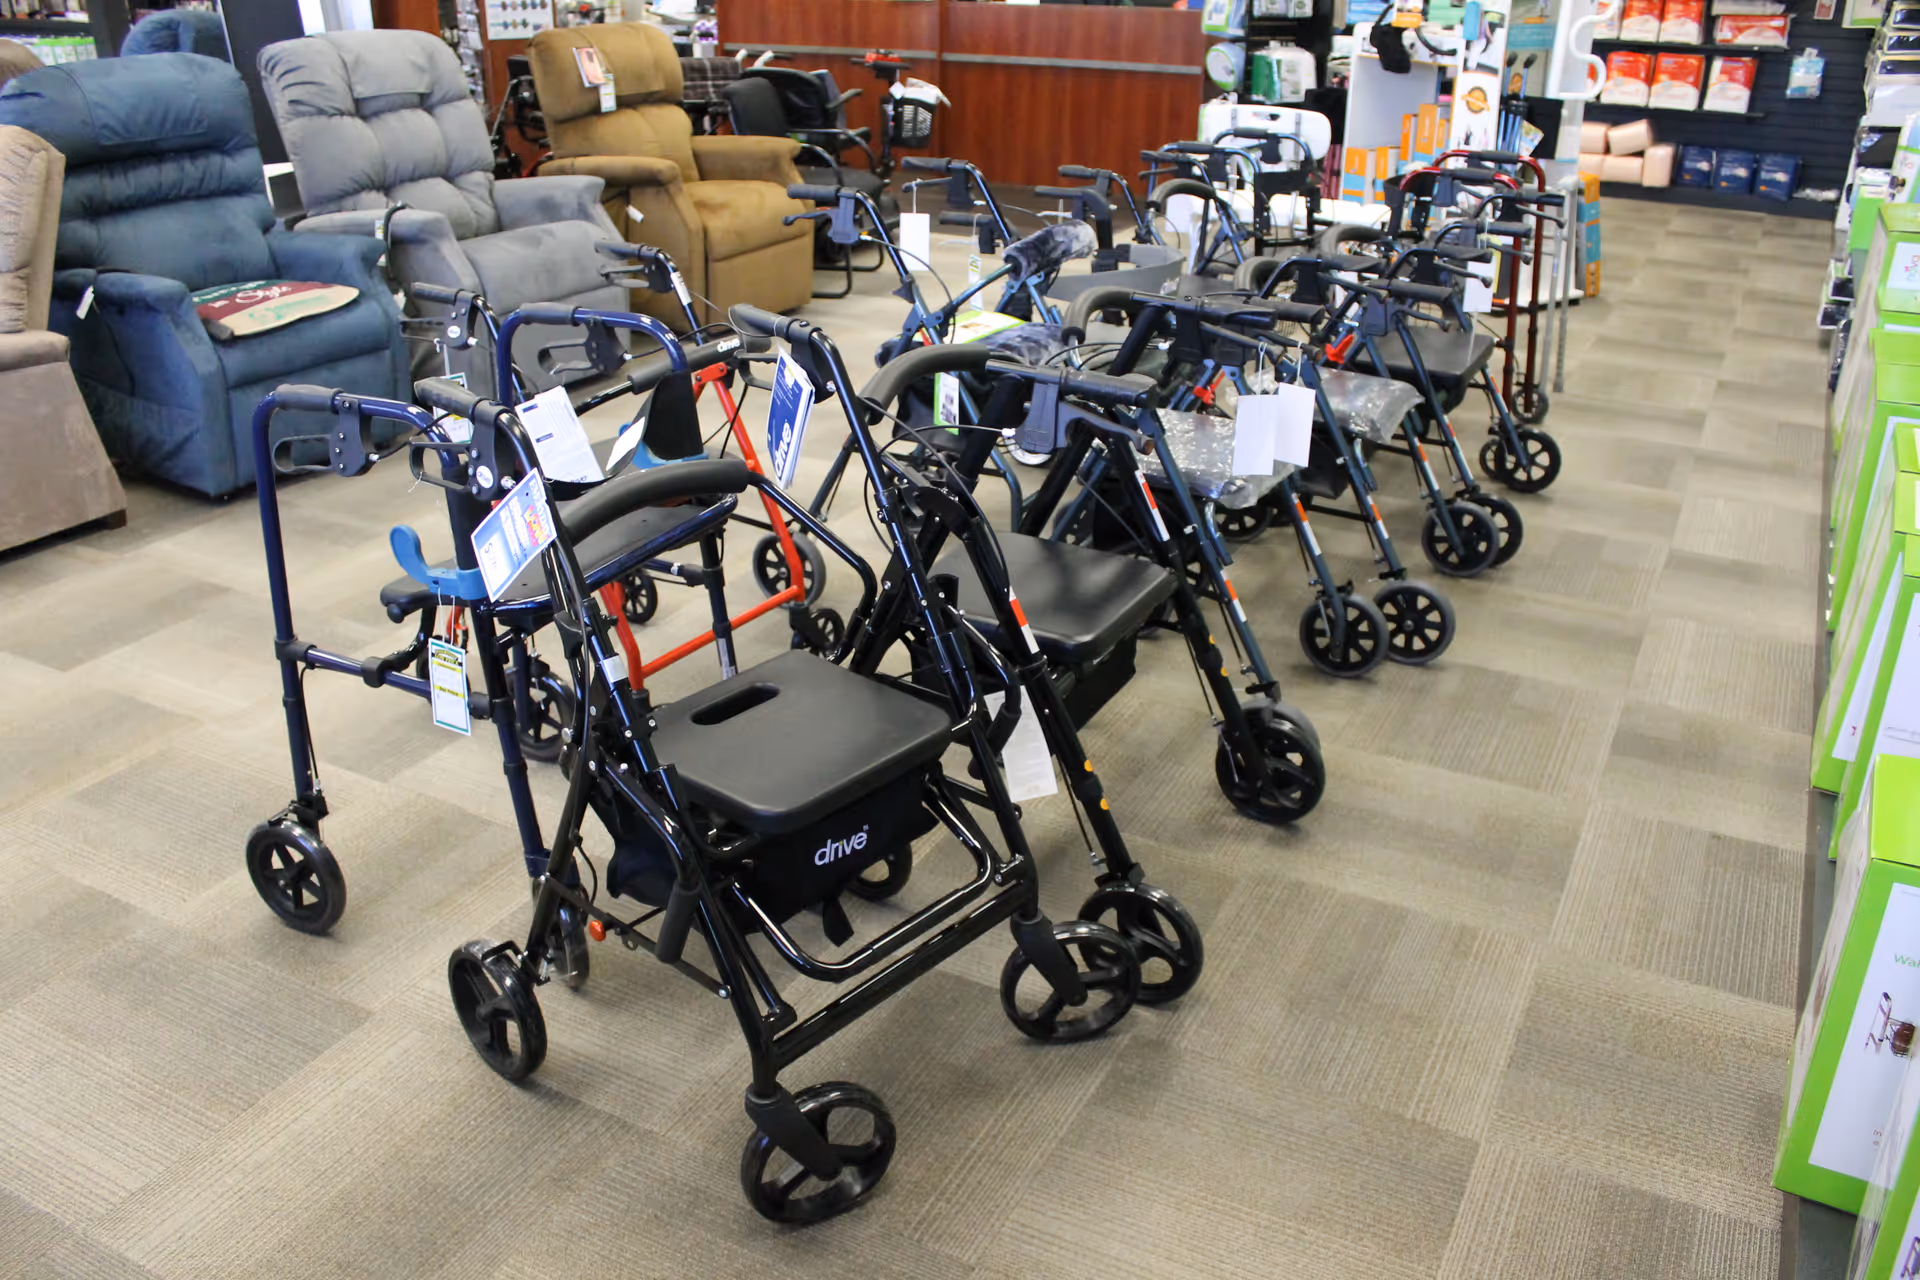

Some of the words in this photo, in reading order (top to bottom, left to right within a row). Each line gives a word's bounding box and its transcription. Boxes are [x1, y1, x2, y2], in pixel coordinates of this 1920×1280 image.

[717, 338, 741, 353] drive
[775, 422, 791, 478] drive
[814, 832, 868, 866] drive
